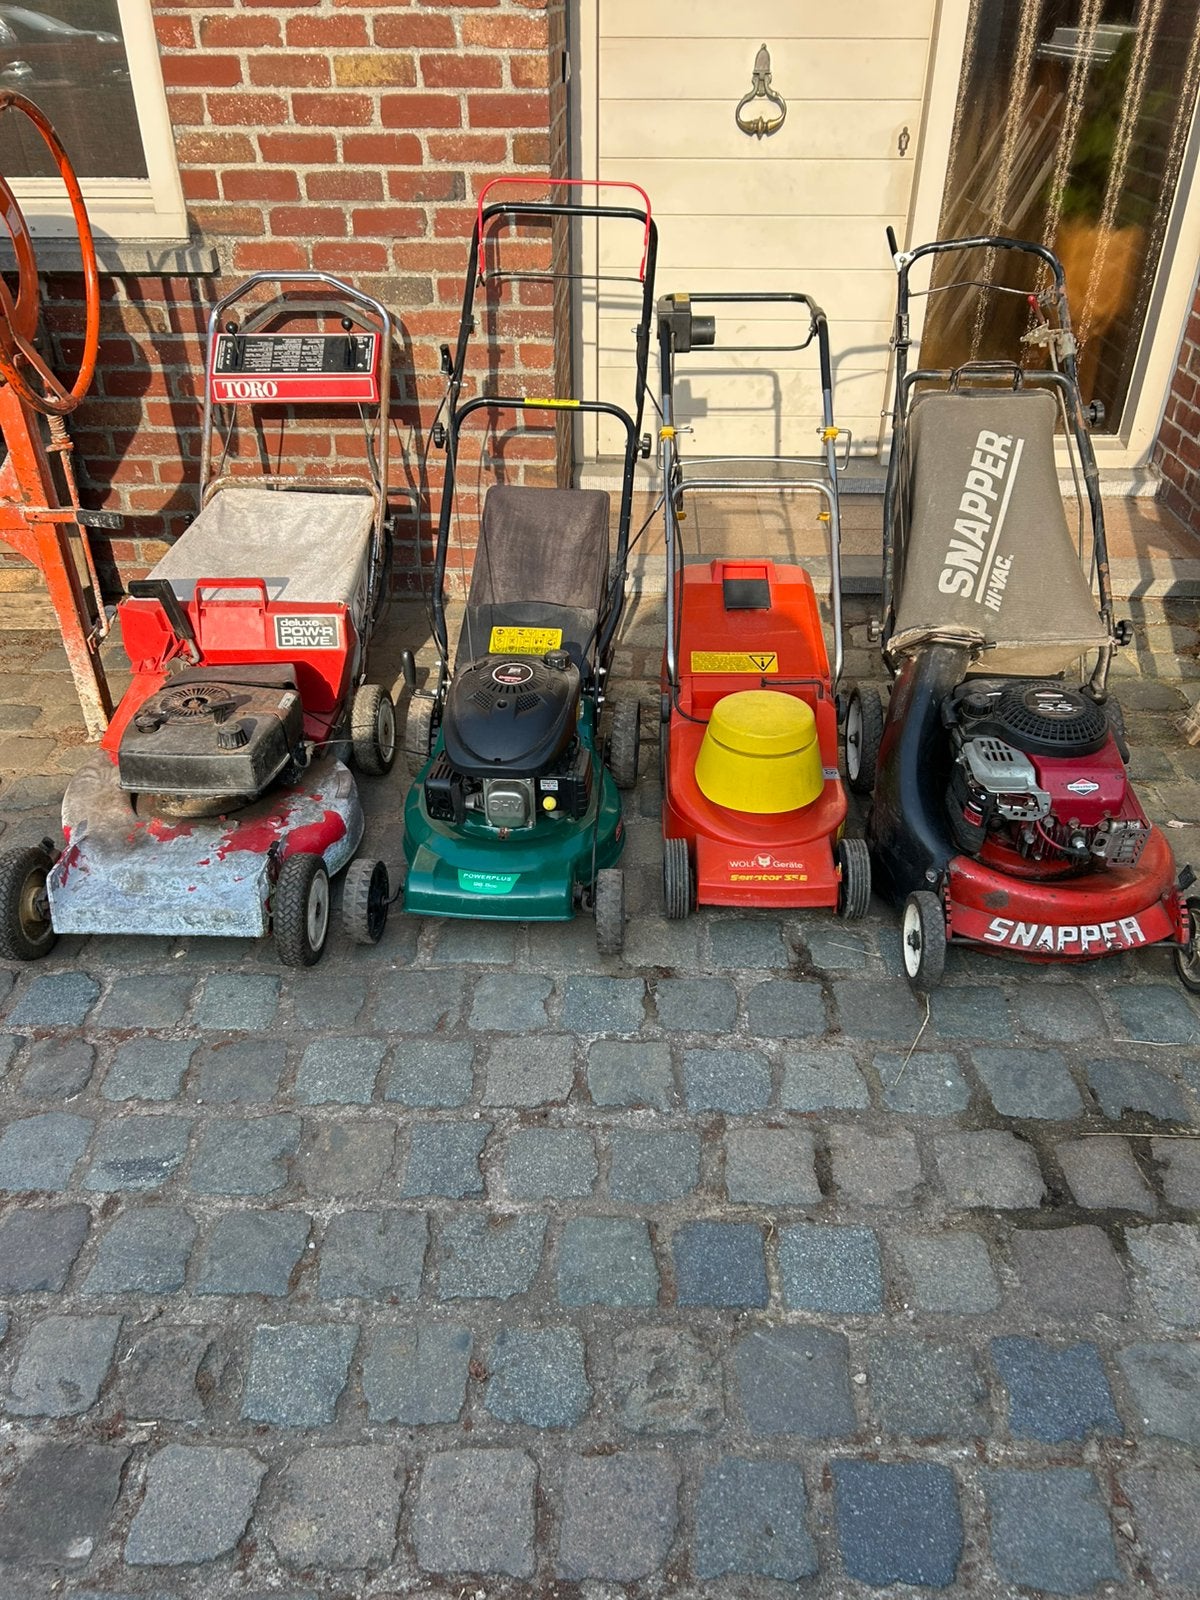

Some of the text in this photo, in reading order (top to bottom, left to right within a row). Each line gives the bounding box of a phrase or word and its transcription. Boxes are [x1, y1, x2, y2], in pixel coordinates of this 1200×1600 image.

[222, 381, 278, 398] TORO
[938, 429, 1012, 598] SNAPPER
[280, 618, 320, 627] deluxe
[281, 636, 331, 646] DRIVE
[772, 860, 804, 869] Geräte
[463, 873, 511, 882] POWERPLUS
[983, 916, 1147, 950] SNAPPER
